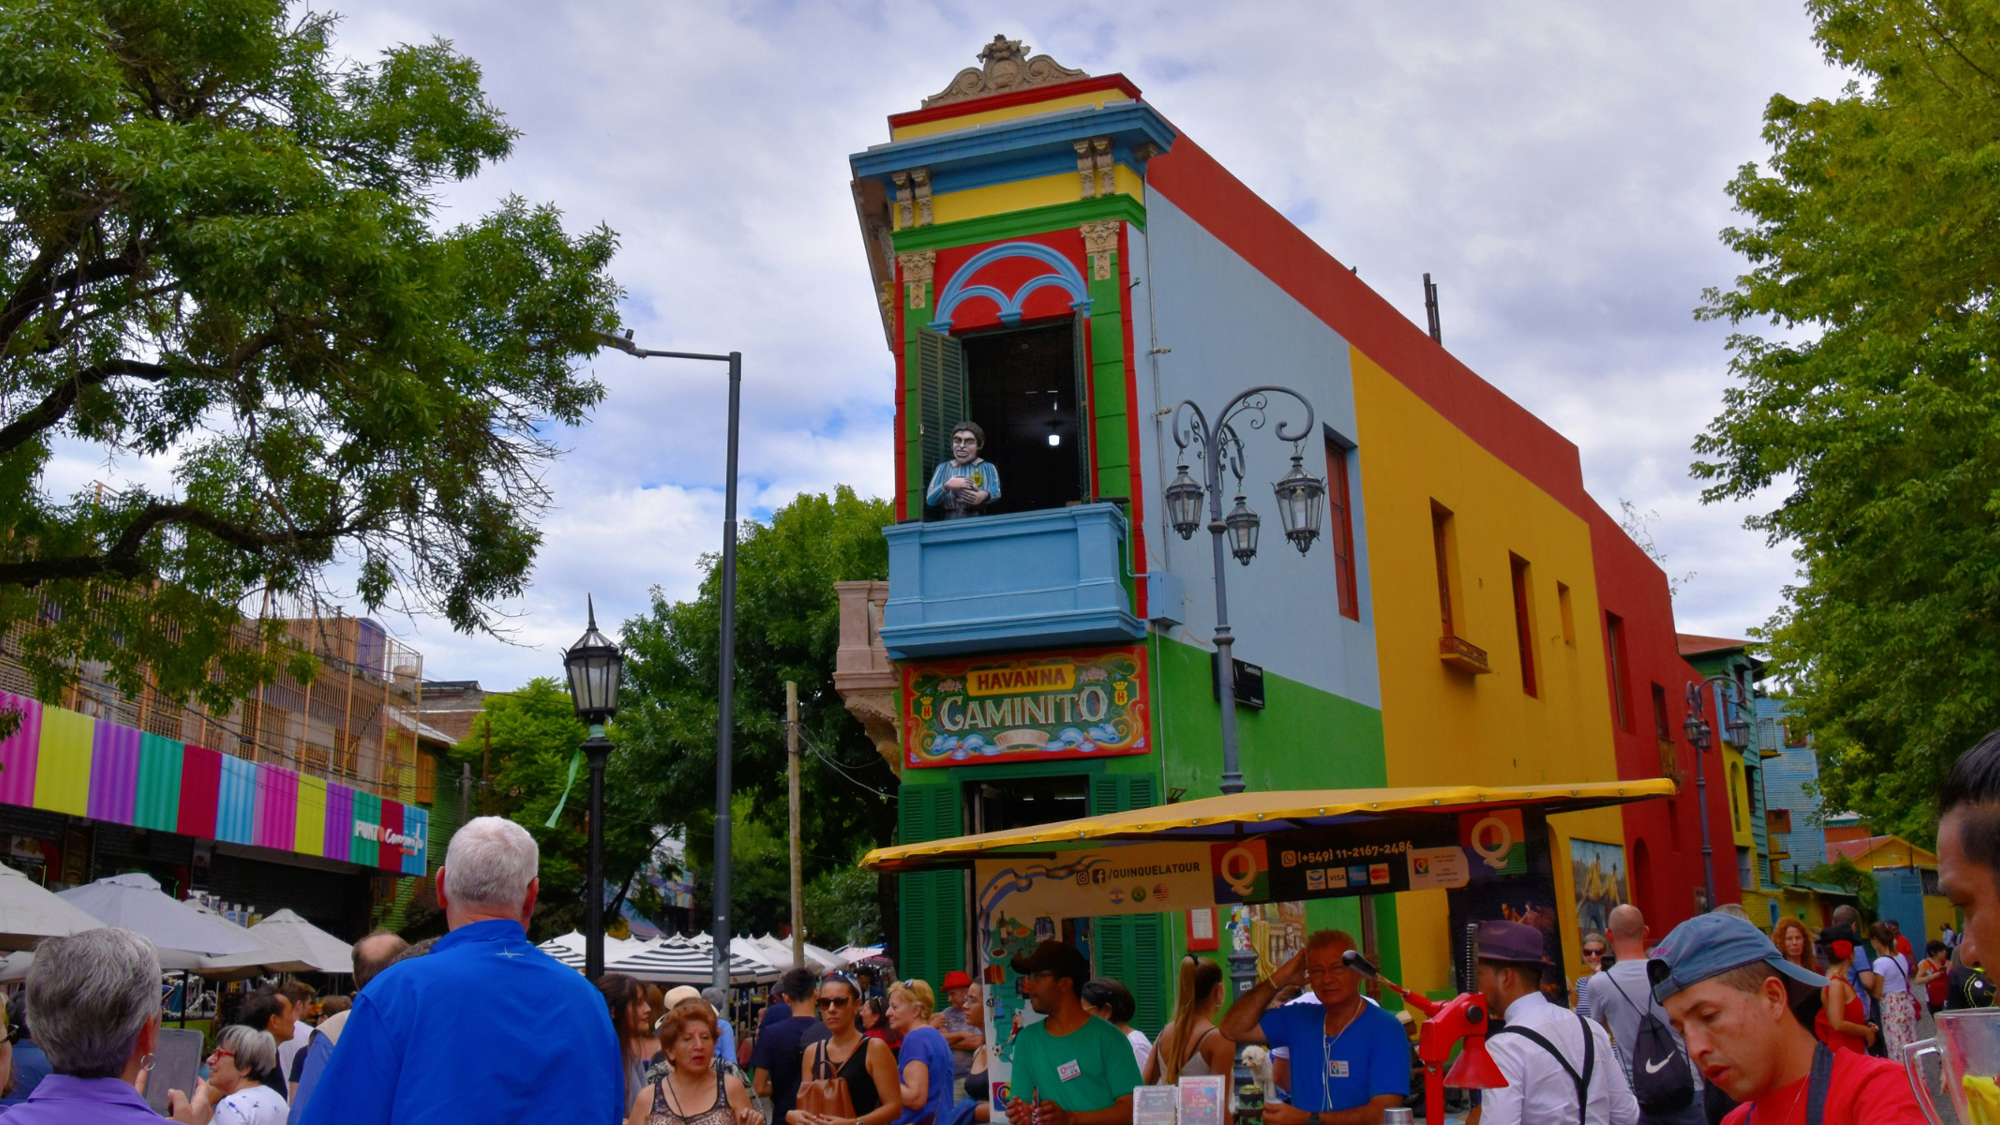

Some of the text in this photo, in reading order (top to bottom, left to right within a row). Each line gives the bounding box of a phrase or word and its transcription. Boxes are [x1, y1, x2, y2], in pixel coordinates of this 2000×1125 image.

[977, 668, 1067, 692] HAVANNA
[939, 686, 1109, 731] CAMINITO
[1116, 692, 1125, 702] H
[923, 707, 931, 718] H
[1298, 840, 1413, 863] (+549) 11-2167-2486
[1471, 817, 1511, 869] Q
[1221, 847, 1259, 895] Q
